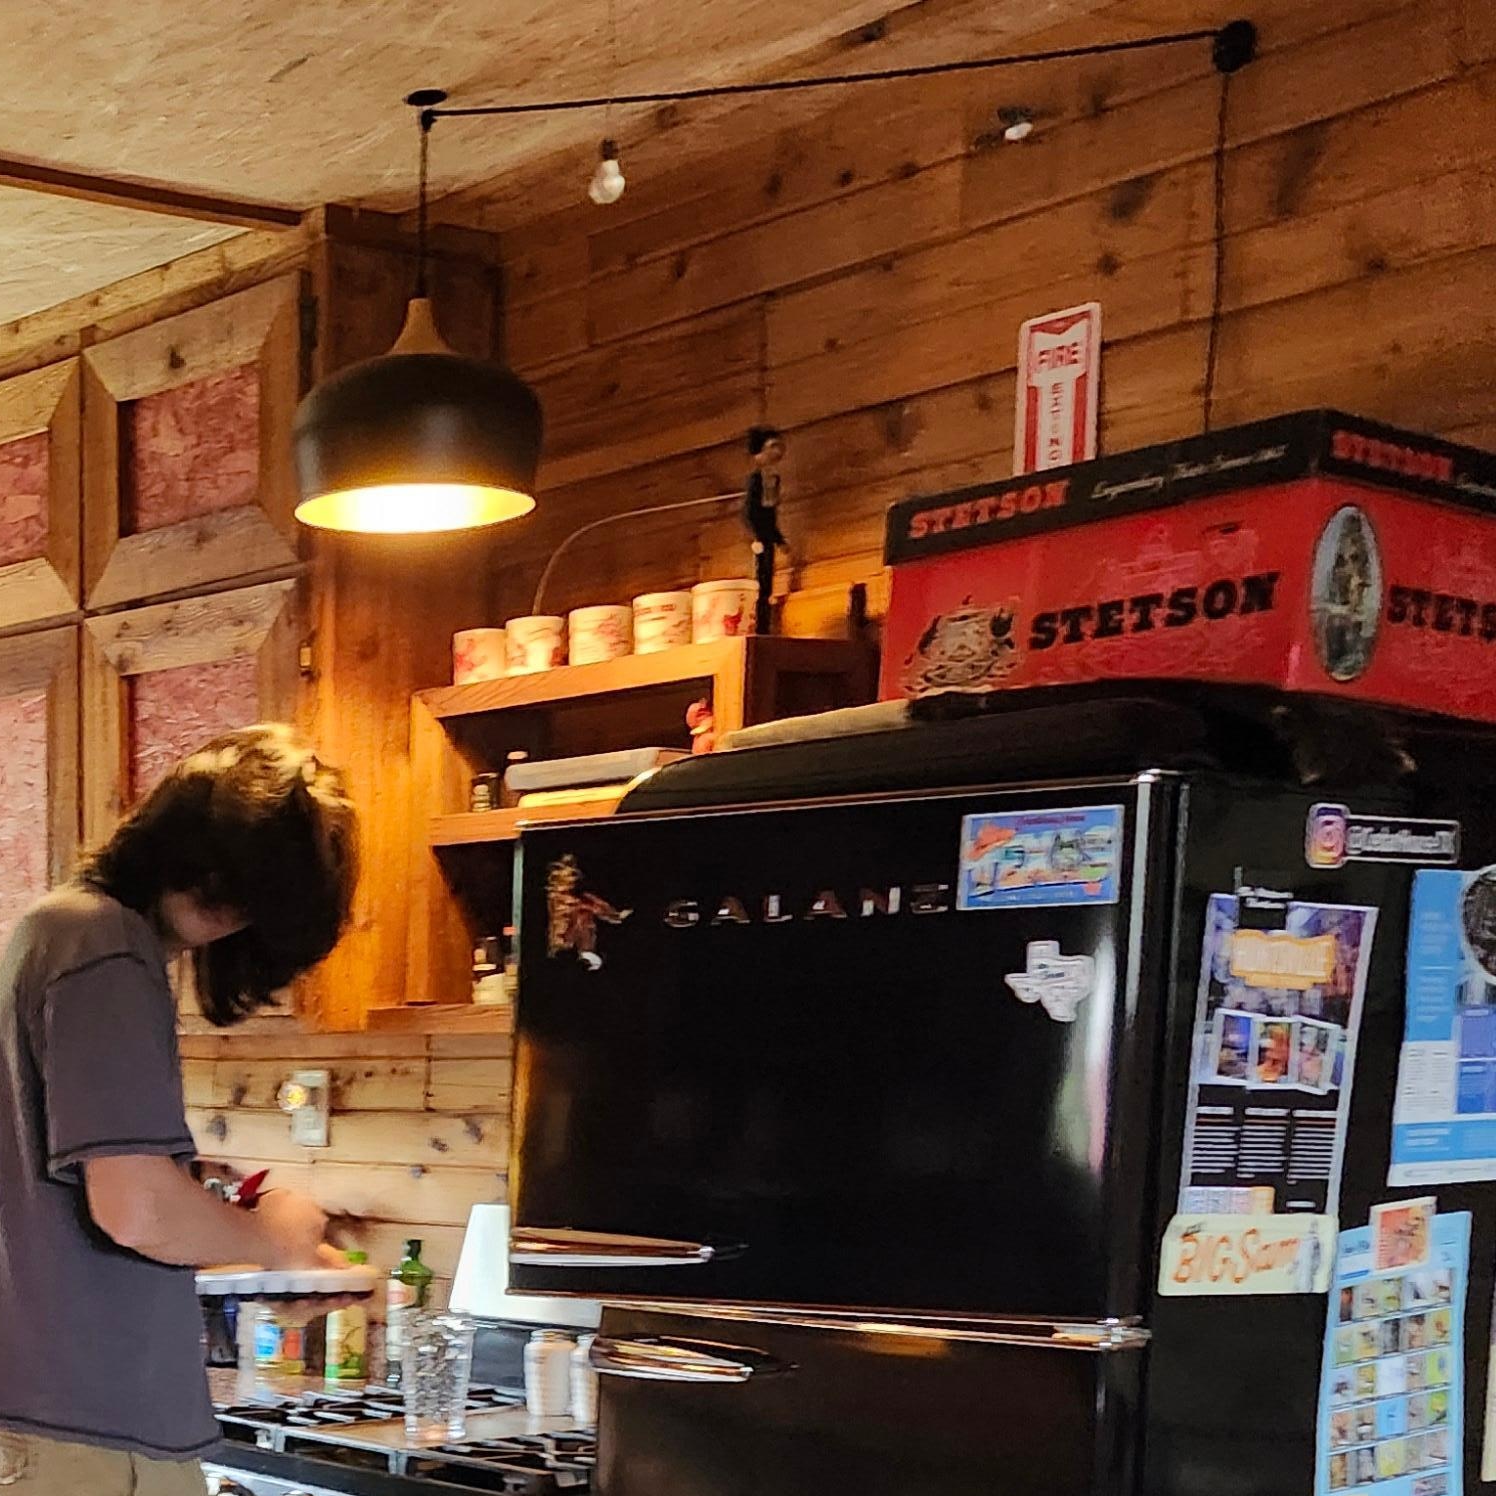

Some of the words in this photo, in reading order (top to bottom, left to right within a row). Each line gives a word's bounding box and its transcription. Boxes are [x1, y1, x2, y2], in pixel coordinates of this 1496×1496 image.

[1038, 342, 1079, 371] FIRE
[910, 479, 1070, 539] STETSON
[1028, 571, 1281, 651] STETSON
[663, 883, 949, 928] GALANZ
